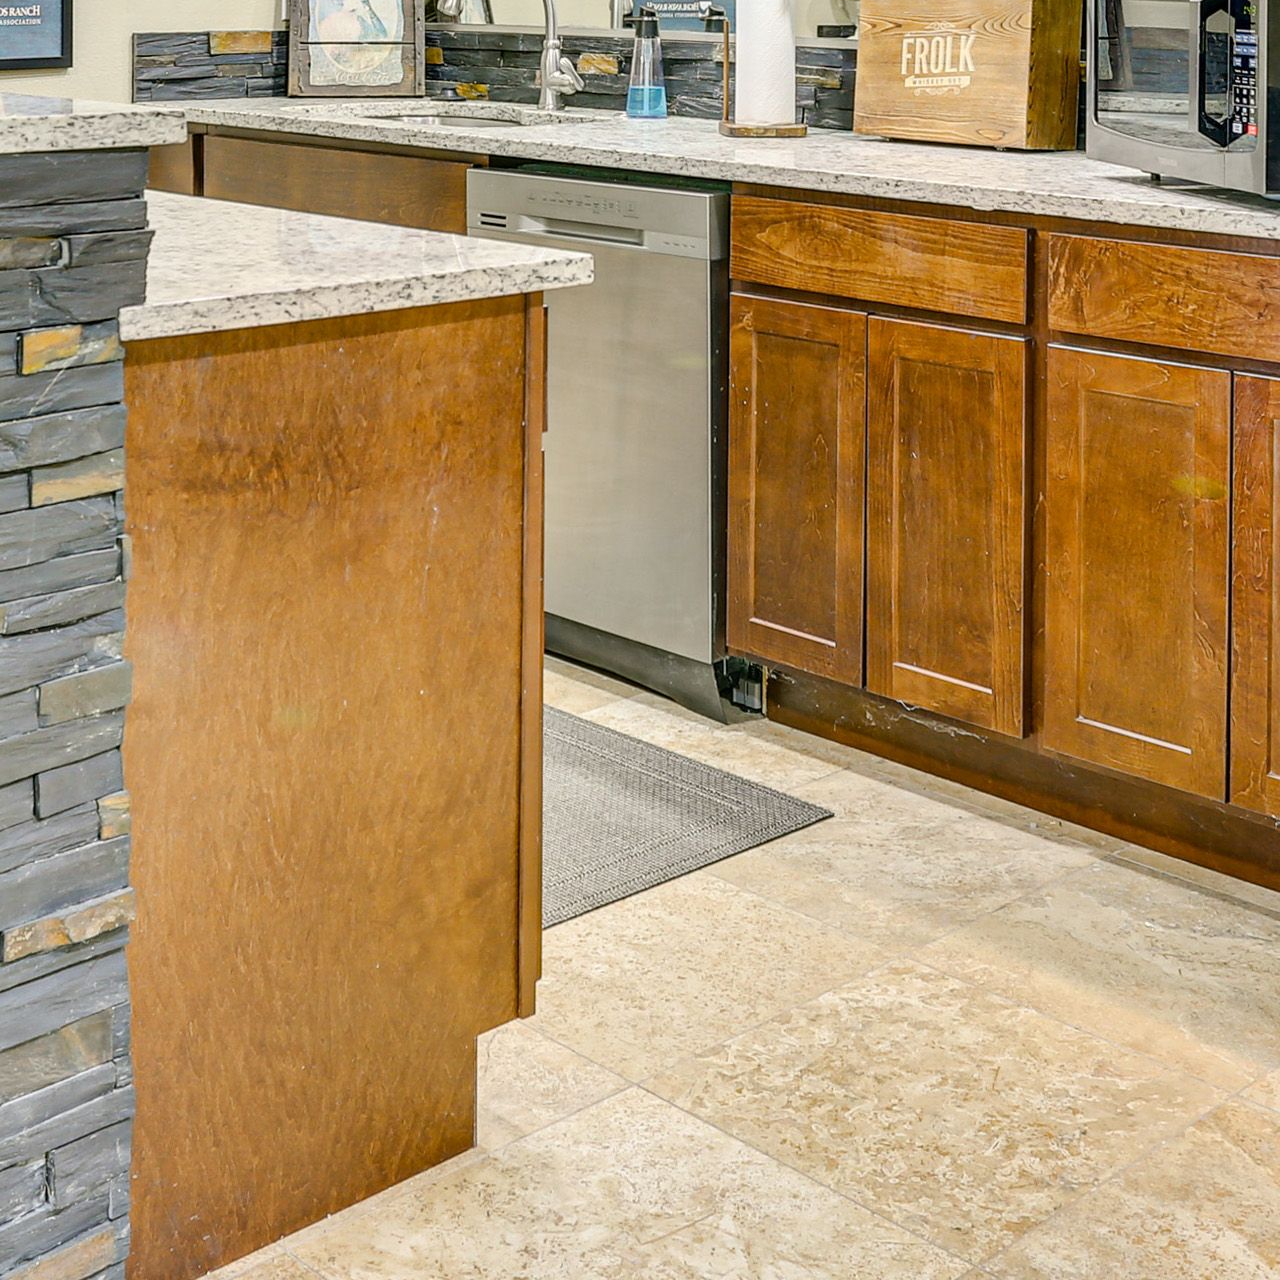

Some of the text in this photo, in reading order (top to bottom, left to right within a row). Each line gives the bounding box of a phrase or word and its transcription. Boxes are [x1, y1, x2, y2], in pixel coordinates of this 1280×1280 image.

[8, 4, 41, 16] RANCH
[0, 18, 42, 26] ASSOCIATION
[901, 32, 977, 75] FROLK
